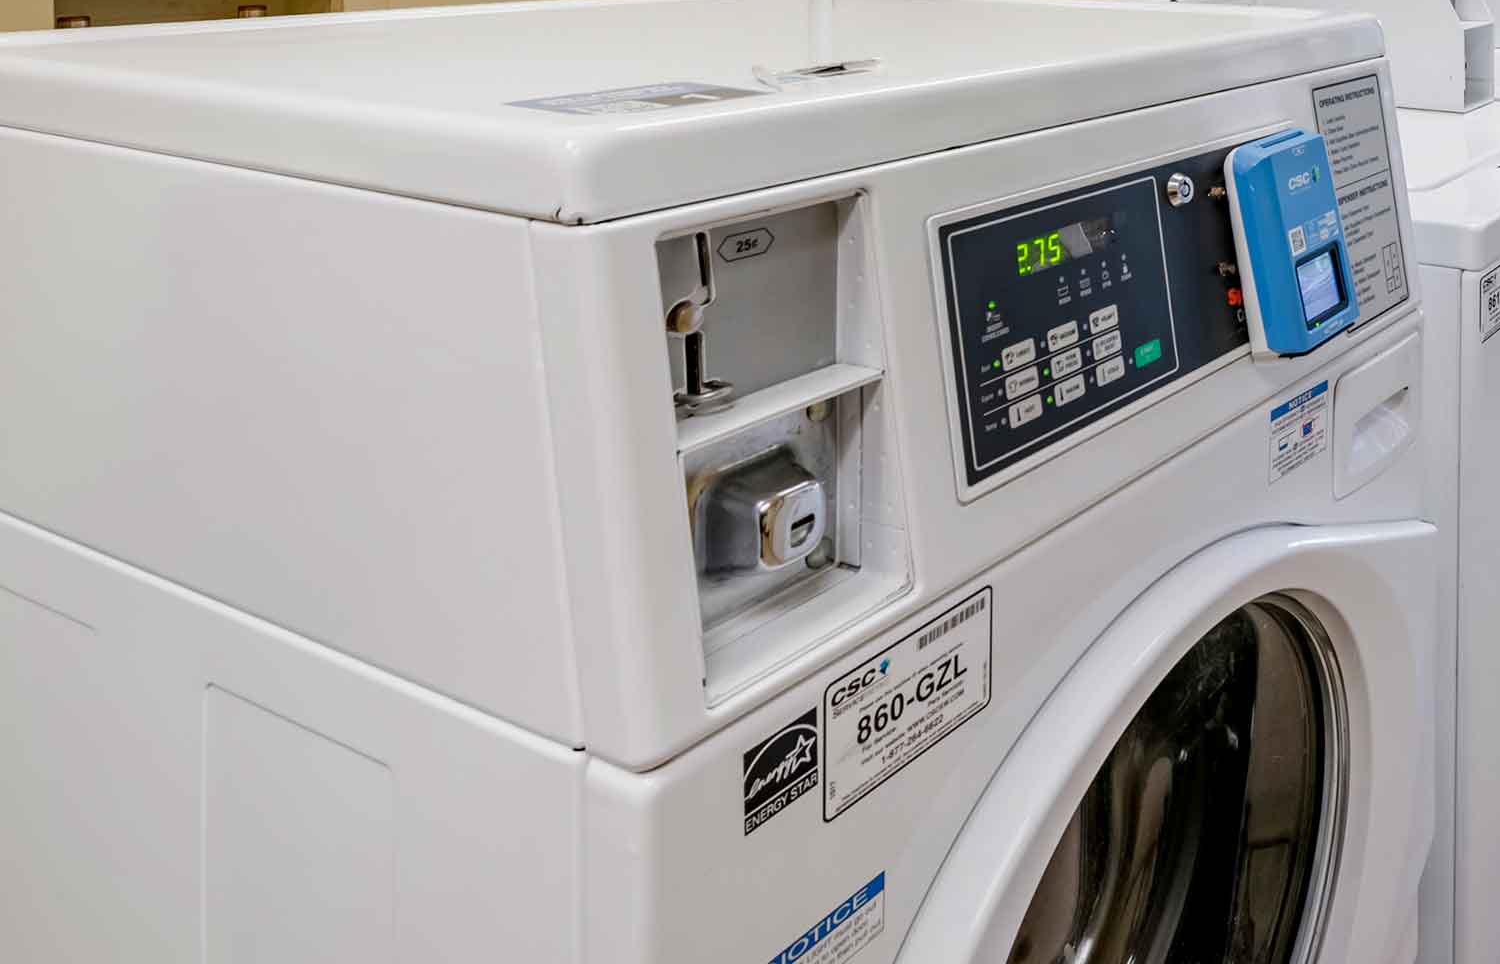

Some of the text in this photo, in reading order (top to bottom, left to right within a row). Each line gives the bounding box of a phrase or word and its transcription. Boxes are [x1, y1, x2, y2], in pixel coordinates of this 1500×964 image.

[1318, 86, 1375, 107] OPERATING INSTRUCTIONS
[1287, 171, 1310, 189] CSC
[735, 238, 758, 252] 25¢
[1016, 233, 1062, 276] 2.75
[1288, 390, 1312, 409] NOTICE
[831, 668, 875, 706] CSC
[856, 653, 967, 744] 860-GZL
[745, 772, 817, 833] ENERGY STAR
